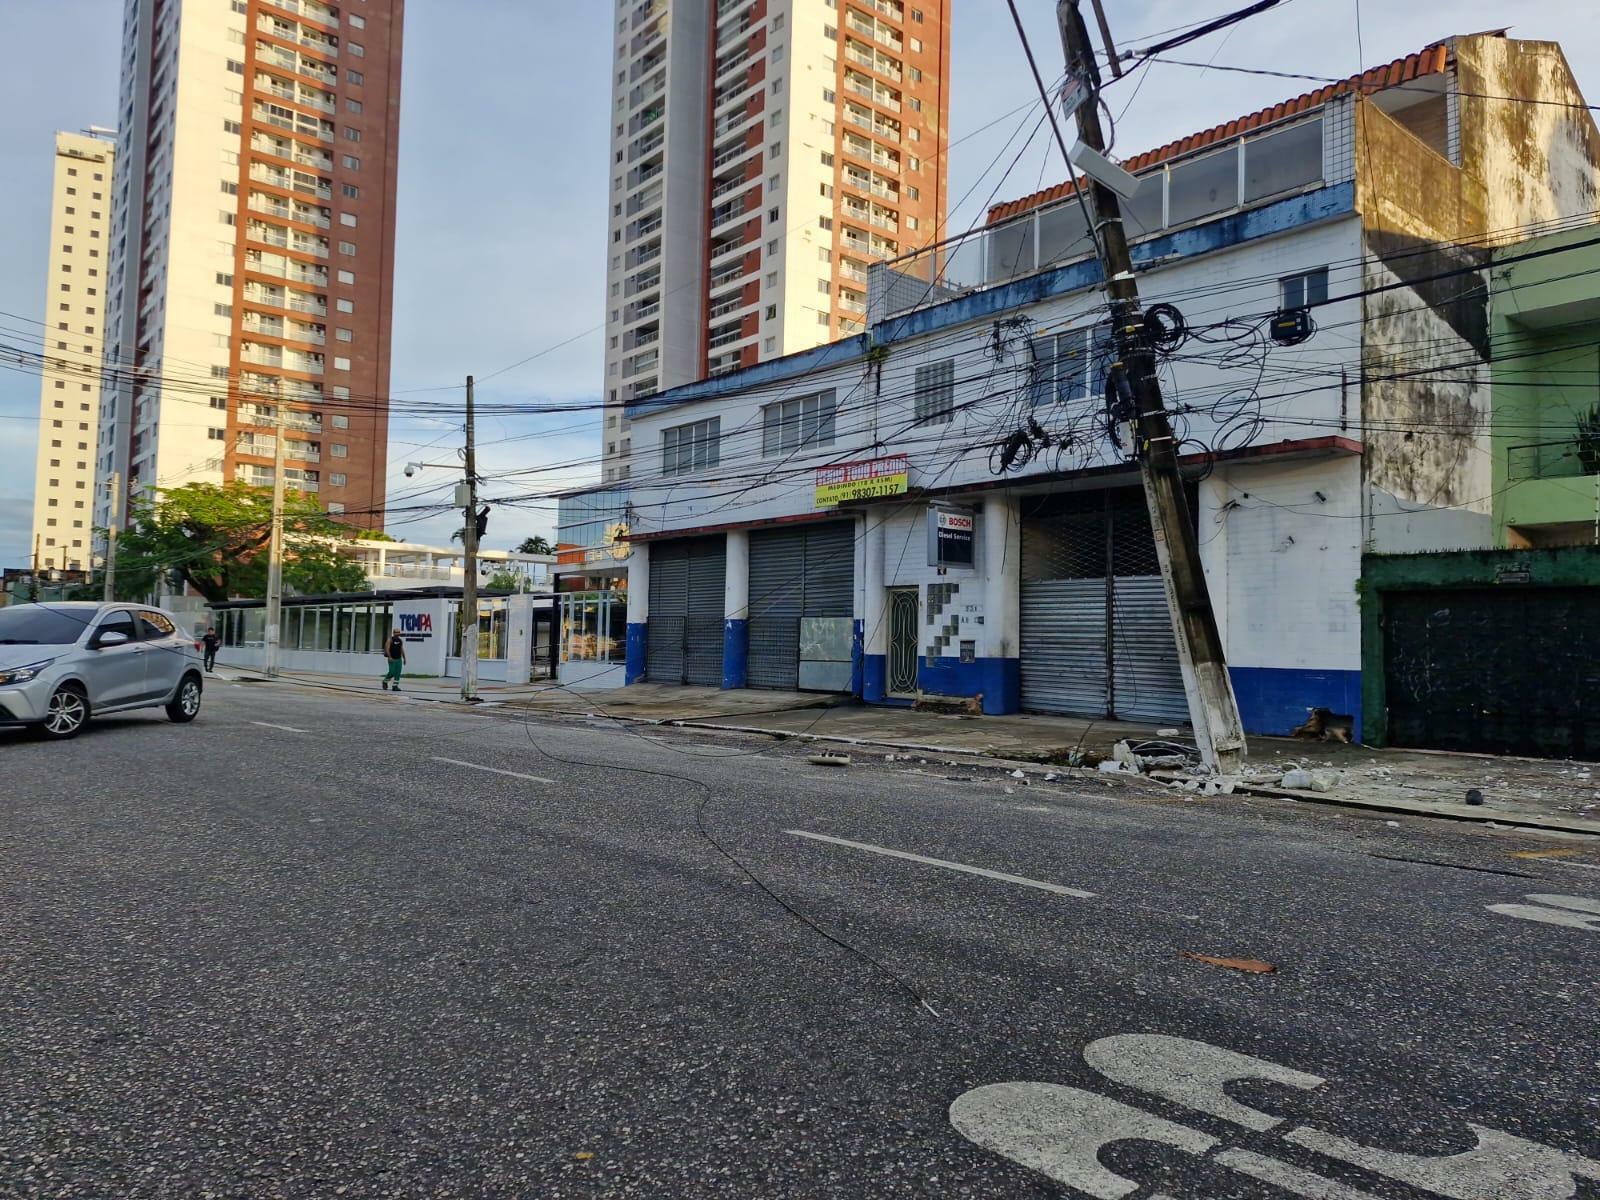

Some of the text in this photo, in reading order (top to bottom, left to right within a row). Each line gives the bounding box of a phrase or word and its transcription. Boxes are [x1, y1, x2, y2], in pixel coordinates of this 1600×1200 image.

[852, 483, 900, 499] 98307-1157
[948, 517, 971, 528] BOSCH
[938, 531, 971, 541] Diesel Service
